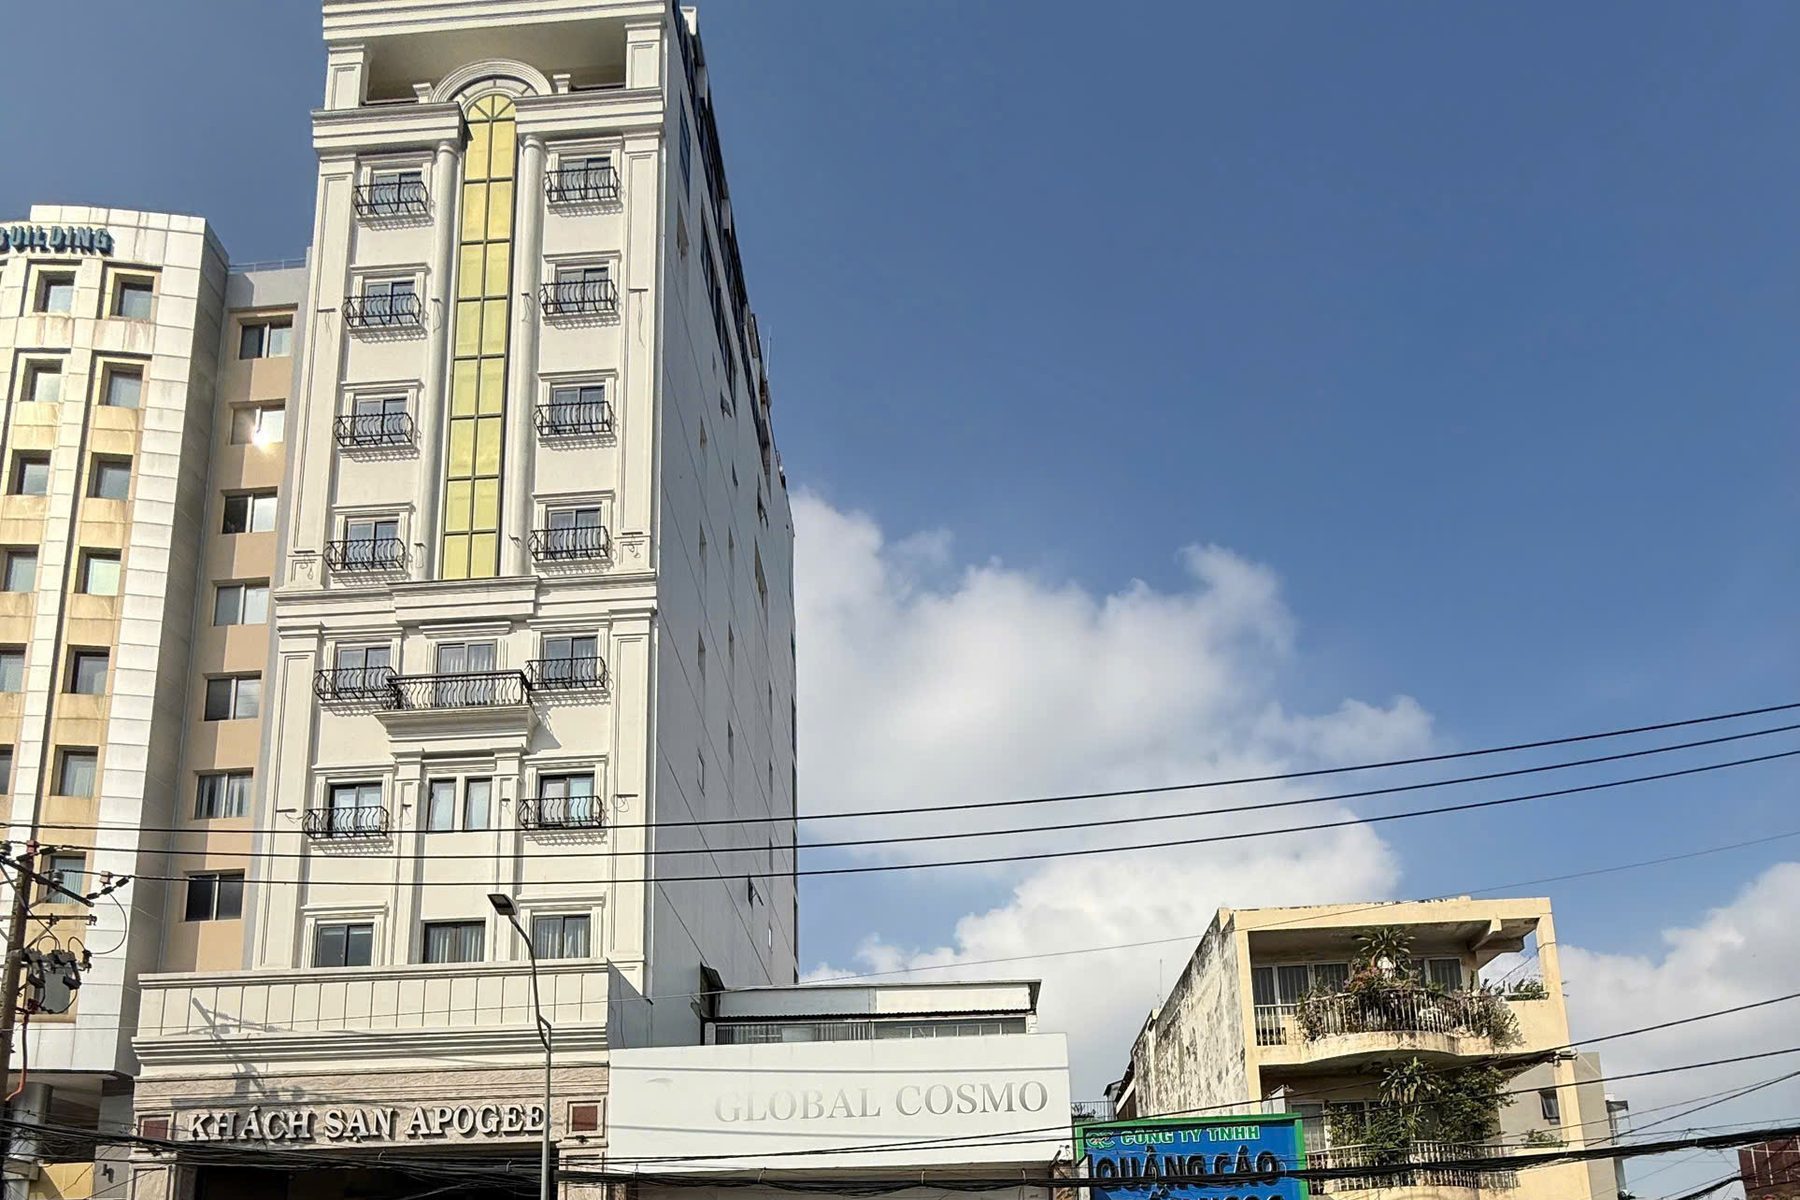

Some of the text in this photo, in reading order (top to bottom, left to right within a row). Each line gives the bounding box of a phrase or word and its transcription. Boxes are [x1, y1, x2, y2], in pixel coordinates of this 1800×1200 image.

[713, 1080, 1049, 1123] GLOBAL COSMO
[186, 1103, 546, 1143] KHÁCH SẠN APOGEE
[1178, 1129, 1201, 1143] TY
[1208, 1125, 1261, 1142] TNHH
